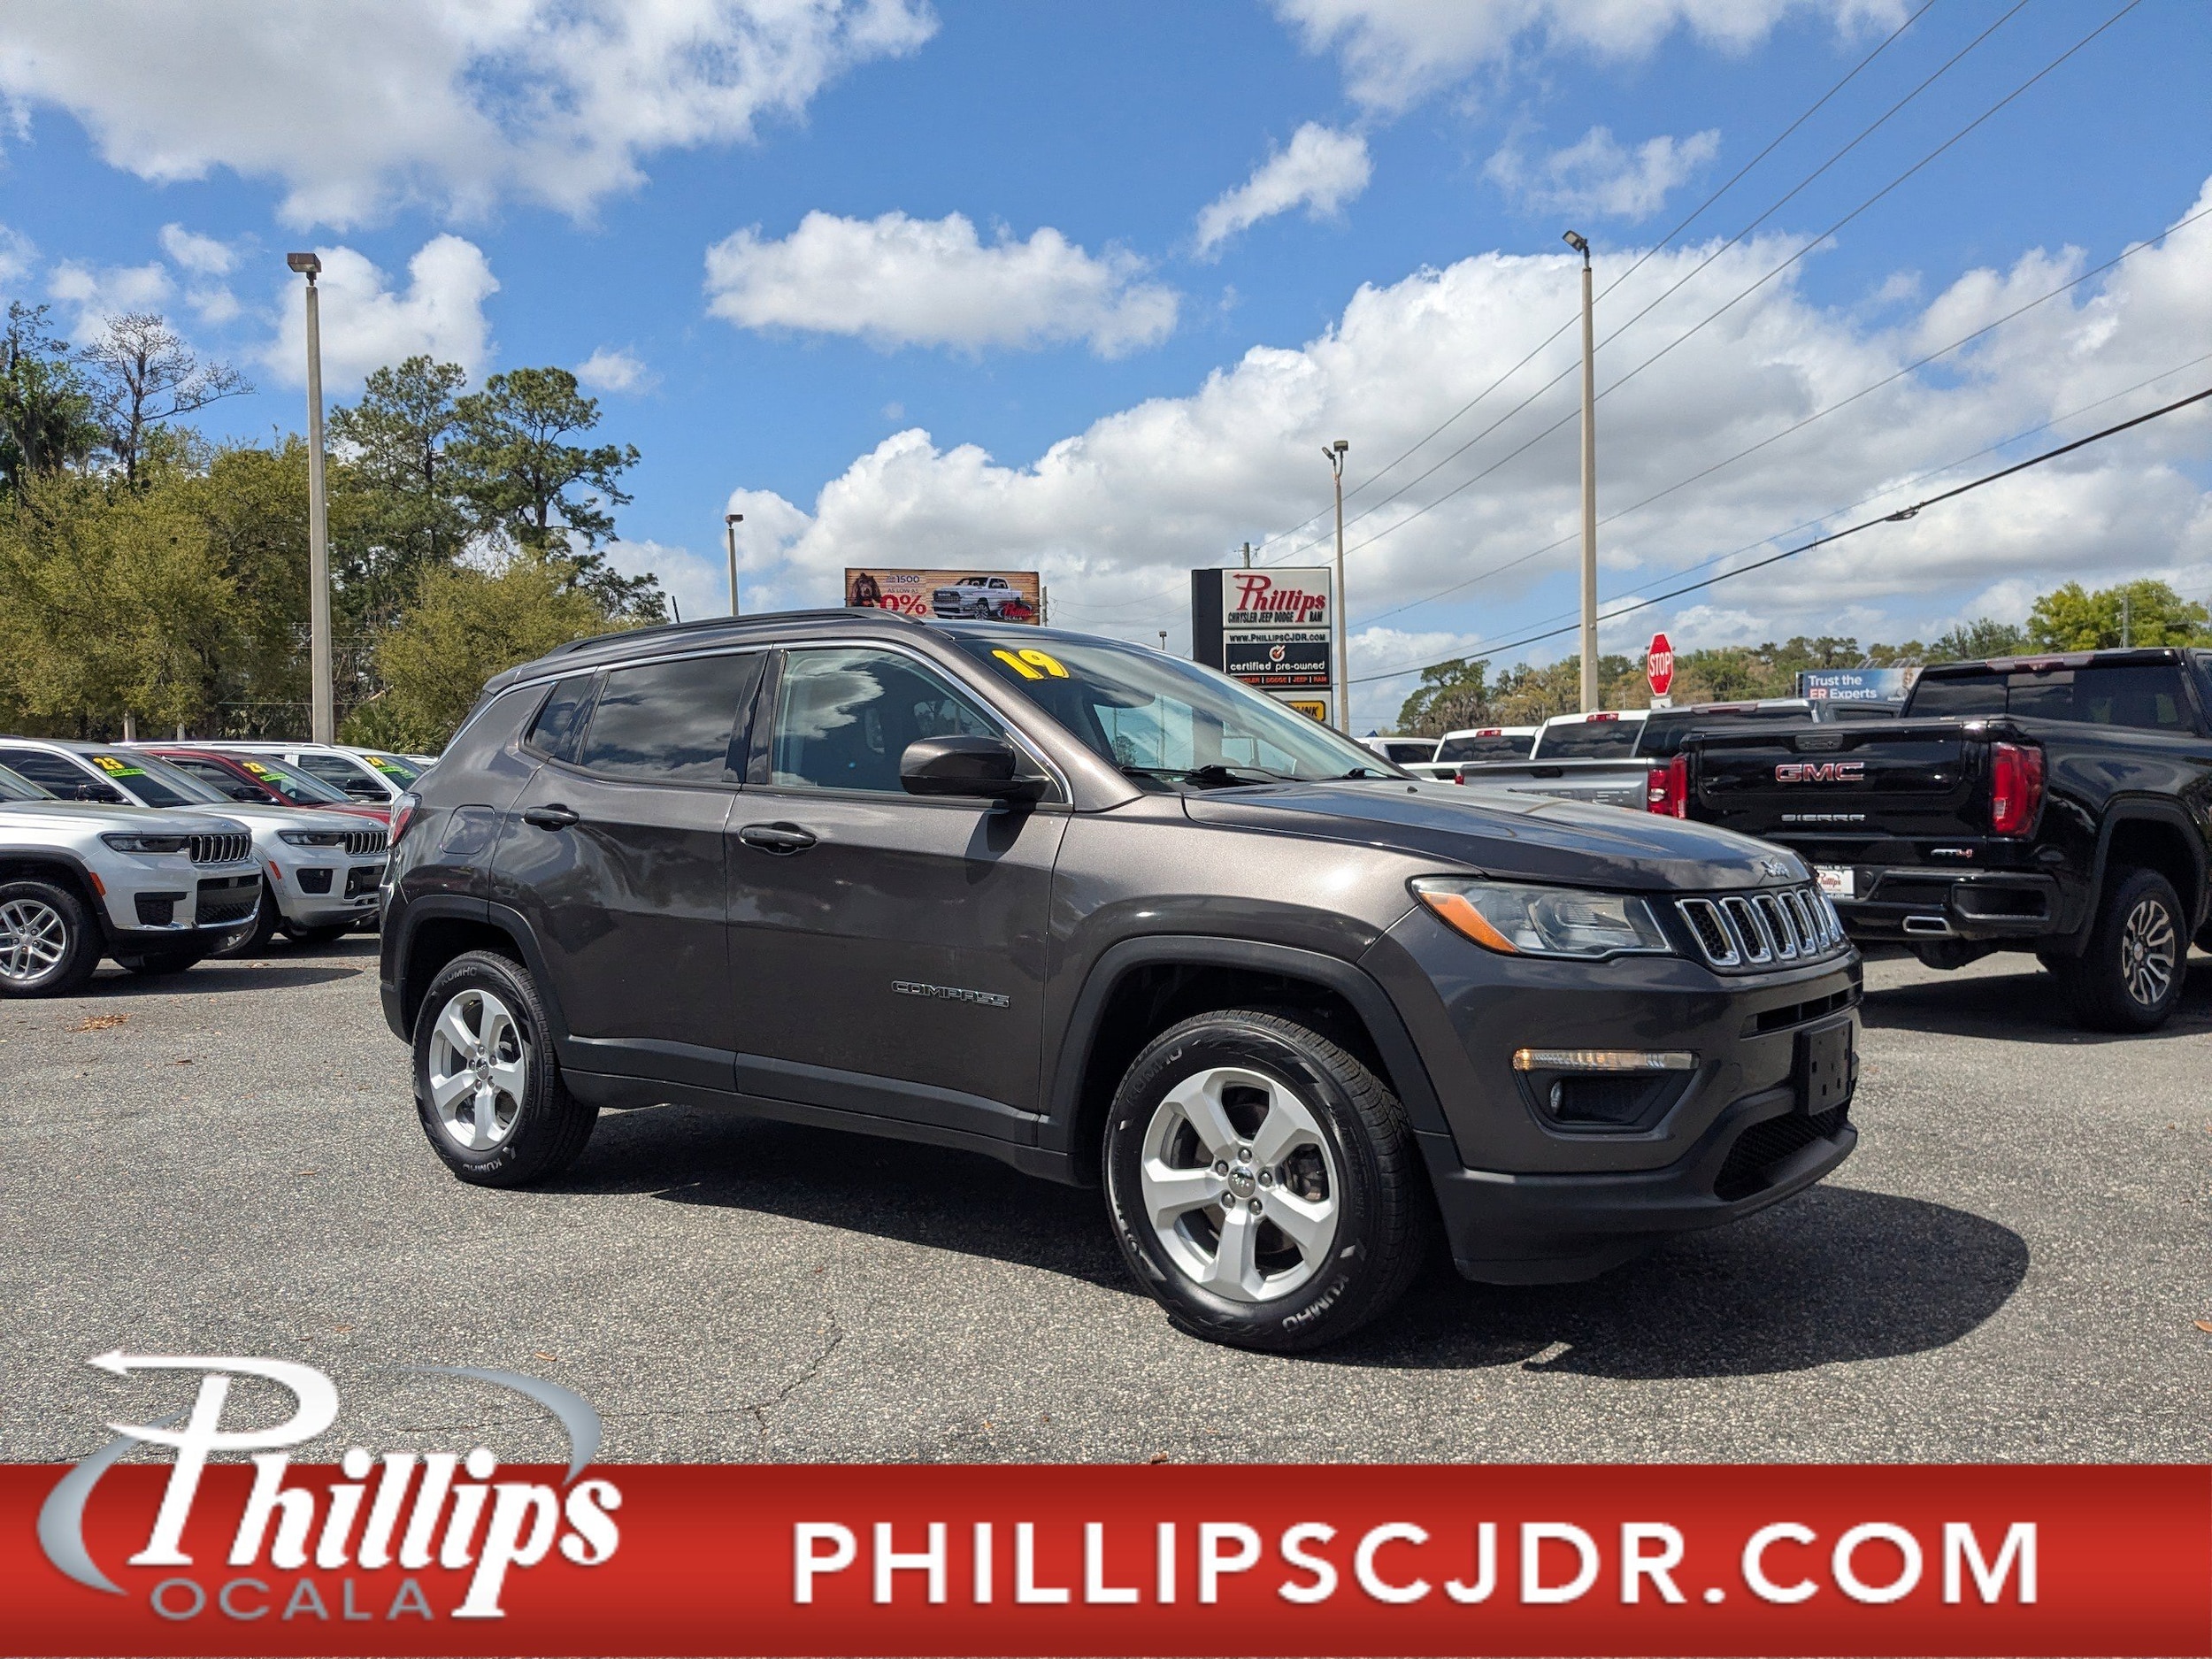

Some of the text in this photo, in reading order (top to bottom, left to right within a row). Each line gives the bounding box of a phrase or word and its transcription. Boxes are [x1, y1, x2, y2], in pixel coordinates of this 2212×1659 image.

[1233, 573, 1326, 623] Phillips
[1228, 611, 1324, 623] CHRYSLER JEEP DODGE RAM
[992, 649, 1070, 680] 19
[1230, 661, 1325, 672] certified pre-owned
[1649, 651, 1671, 677] STOP
[1808, 674, 1863, 687] Trust the
[1809, 689, 1828, 699] ER
[1829, 688, 1877, 699] Experts
[93, 757, 126, 771] 23
[1775, 762, 1865, 782] GMC
[891, 980, 1010, 1008] COMPASS
